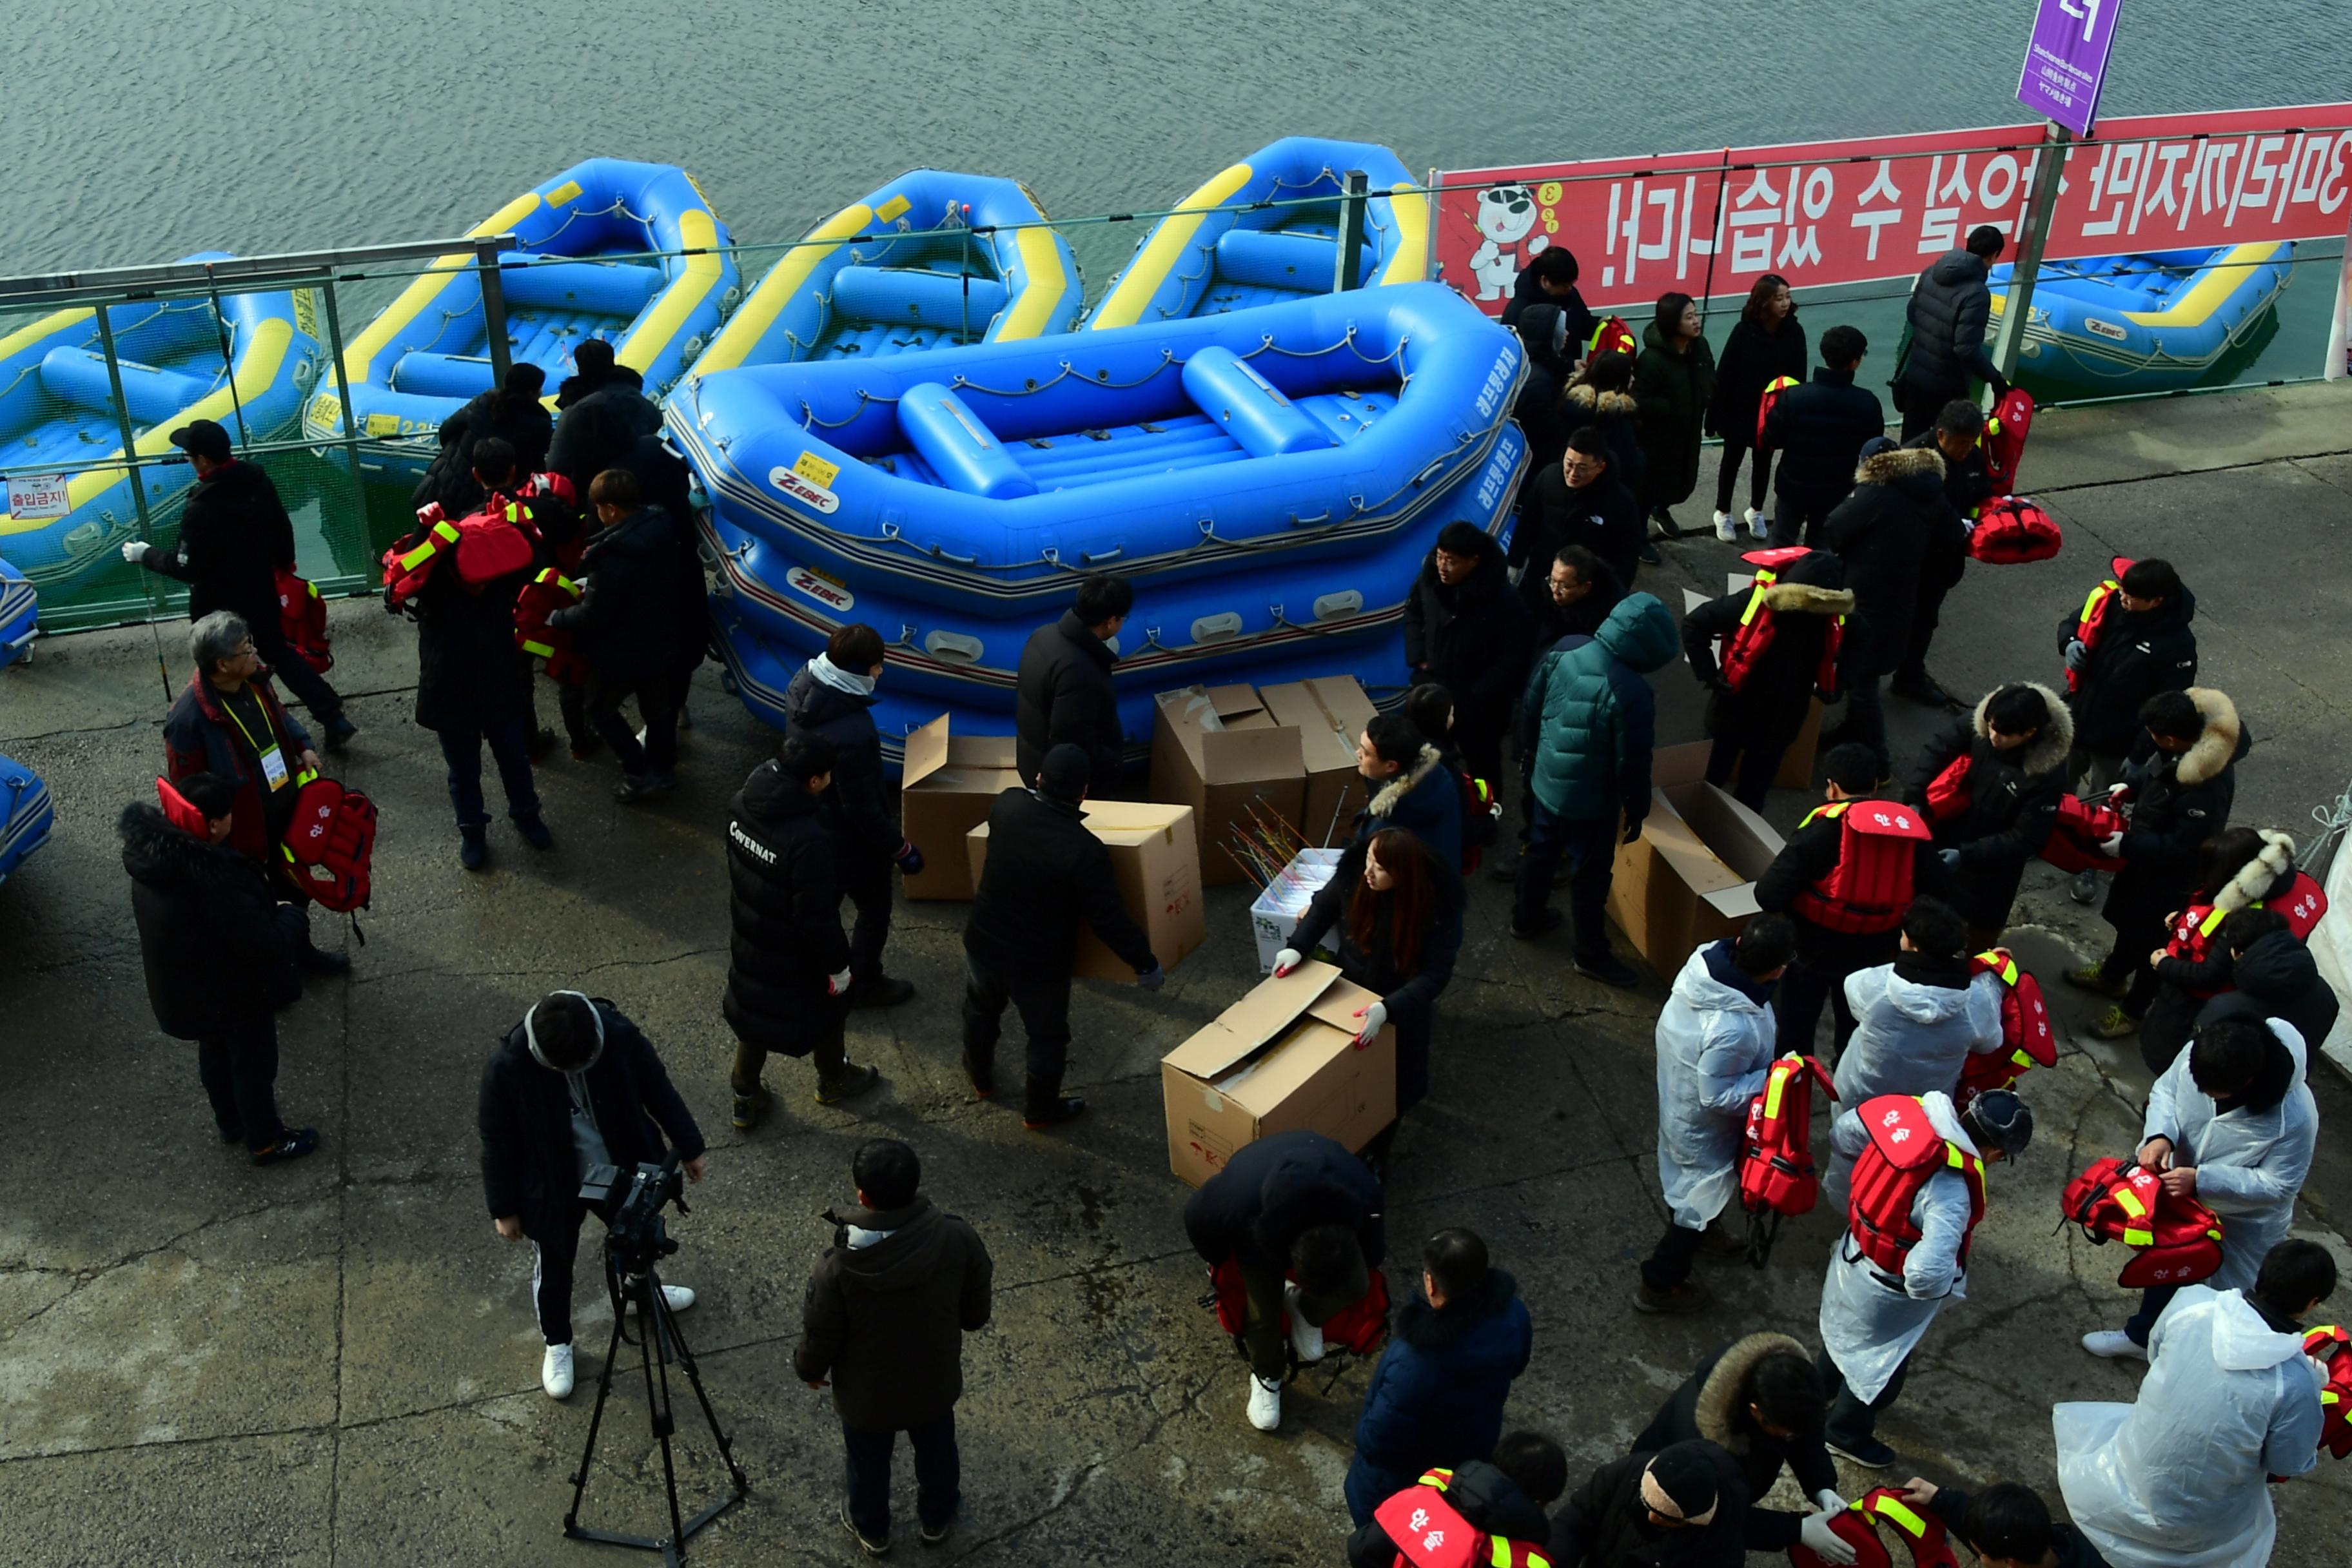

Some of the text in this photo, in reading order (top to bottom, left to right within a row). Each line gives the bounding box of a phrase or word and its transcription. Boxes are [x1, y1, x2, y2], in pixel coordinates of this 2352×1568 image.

[12, 491, 66, 506] 출입금지!
[776, 473, 832, 507] ZEBEC
[729, 820, 777, 865] COVERNAT
[1409, 1507, 1444, 1552] 한솔
